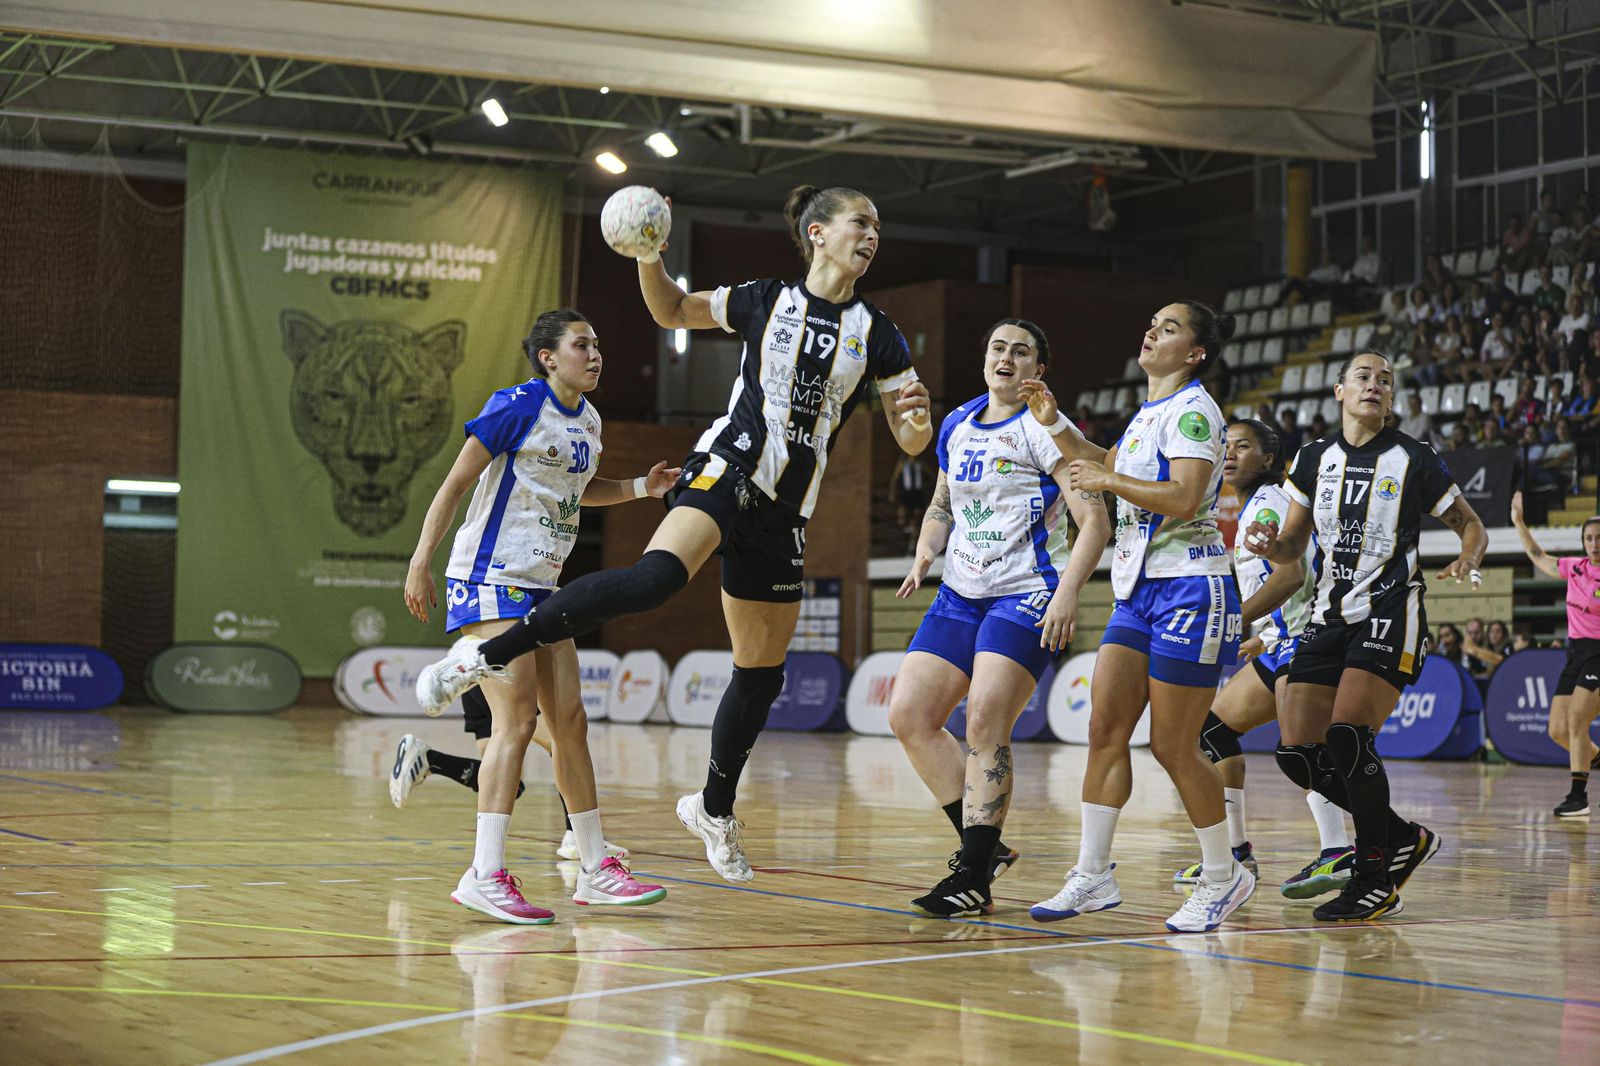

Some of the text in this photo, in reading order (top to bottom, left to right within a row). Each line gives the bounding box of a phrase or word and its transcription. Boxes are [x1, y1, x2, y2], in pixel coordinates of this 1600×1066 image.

[261, 227, 331, 253] juntas
[334, 237, 426, 259] cazamos
[283, 250, 389, 275] jugadoras
[393, 261, 407, 281] y
[331, 276, 430, 300] CBFMCS
[804, 325, 837, 360] 19
[566, 440, 590, 474] 30
[955, 449, 987, 482] 36
[1344, 480, 1370, 505] 17
[967, 530, 1006, 541] RURAL
[1188, 545, 1205, 560] BM
[1166, 608, 1199, 634] 77
[1370, 617, 1393, 640] 17
[0, 660, 94, 678] ICTORIA
